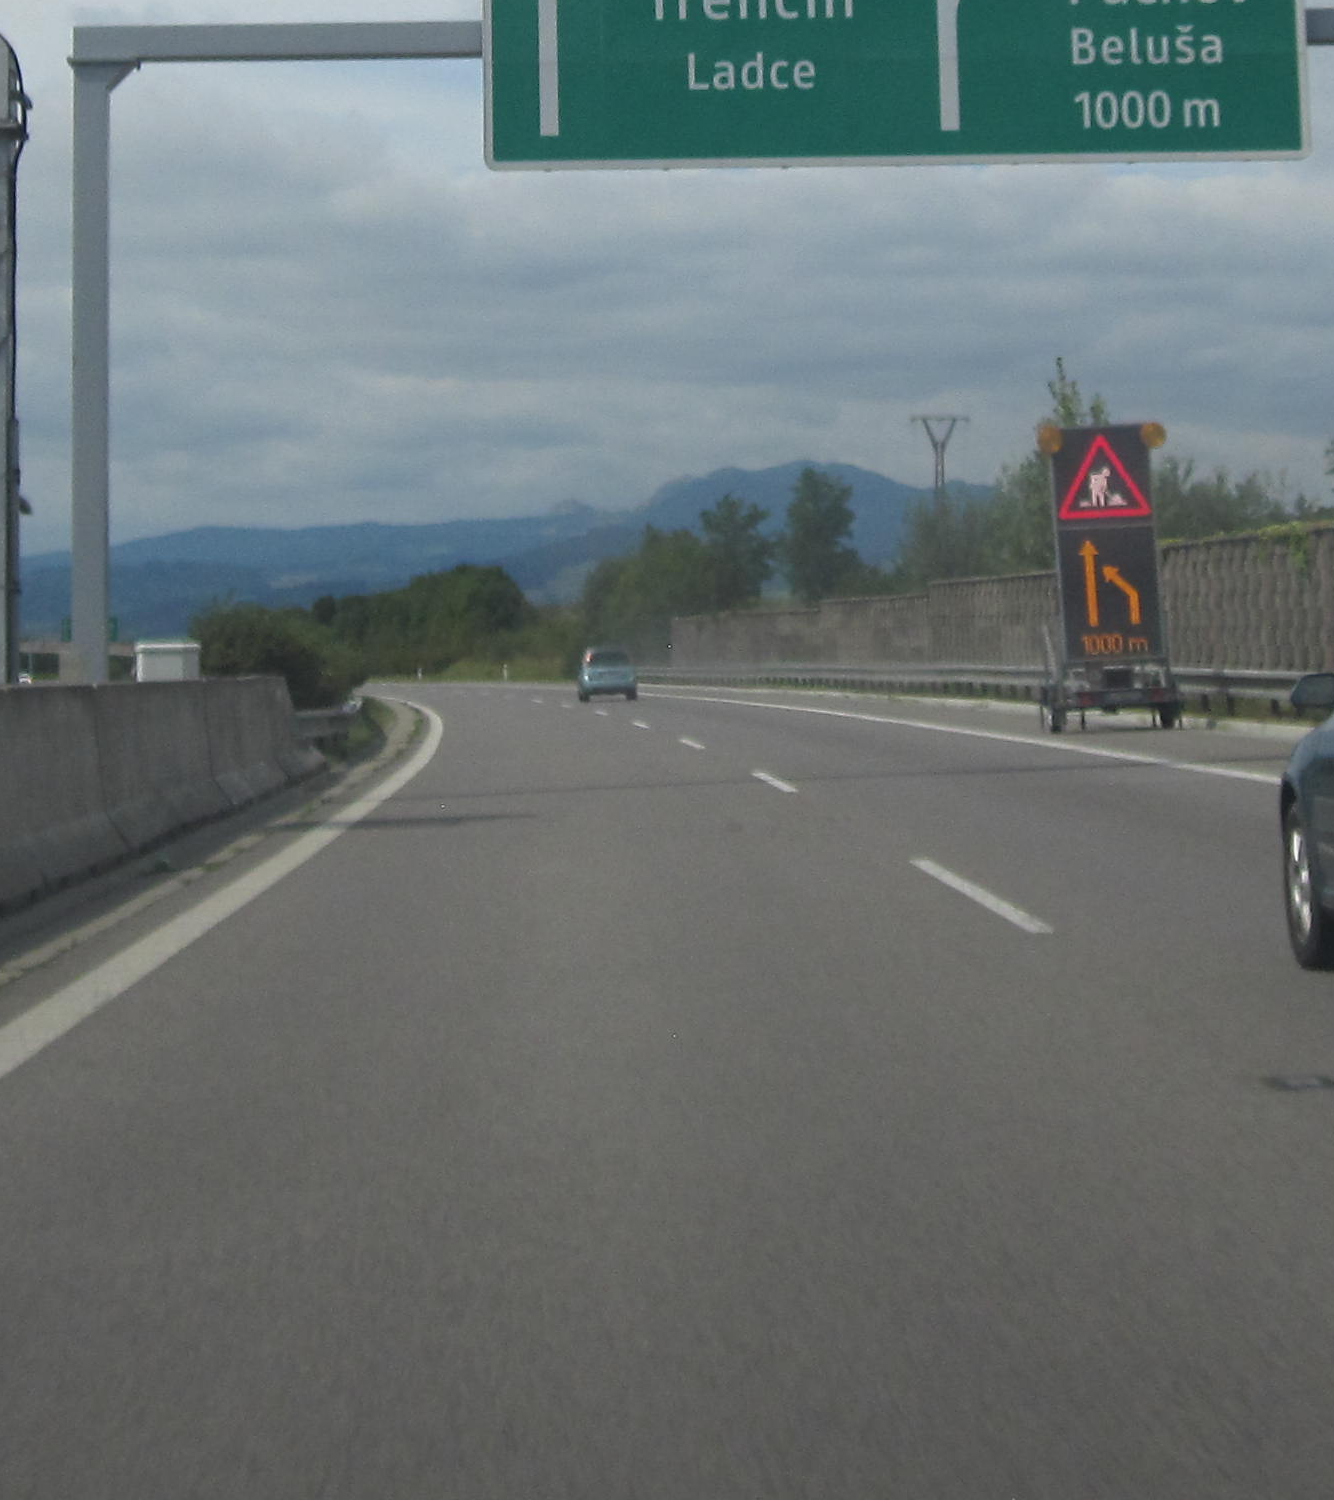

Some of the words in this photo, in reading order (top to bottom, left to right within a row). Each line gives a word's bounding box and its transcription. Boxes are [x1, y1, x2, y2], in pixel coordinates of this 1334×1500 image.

[1070, 24, 1223, 66] Beluša
[687, 51, 816, 91] Ladce
[1074, 90, 1172, 130] 1000
[1183, 98, 1221, 128] m
[1082, 633, 1123, 654] 1000
[1129, 637, 1148, 653] m
